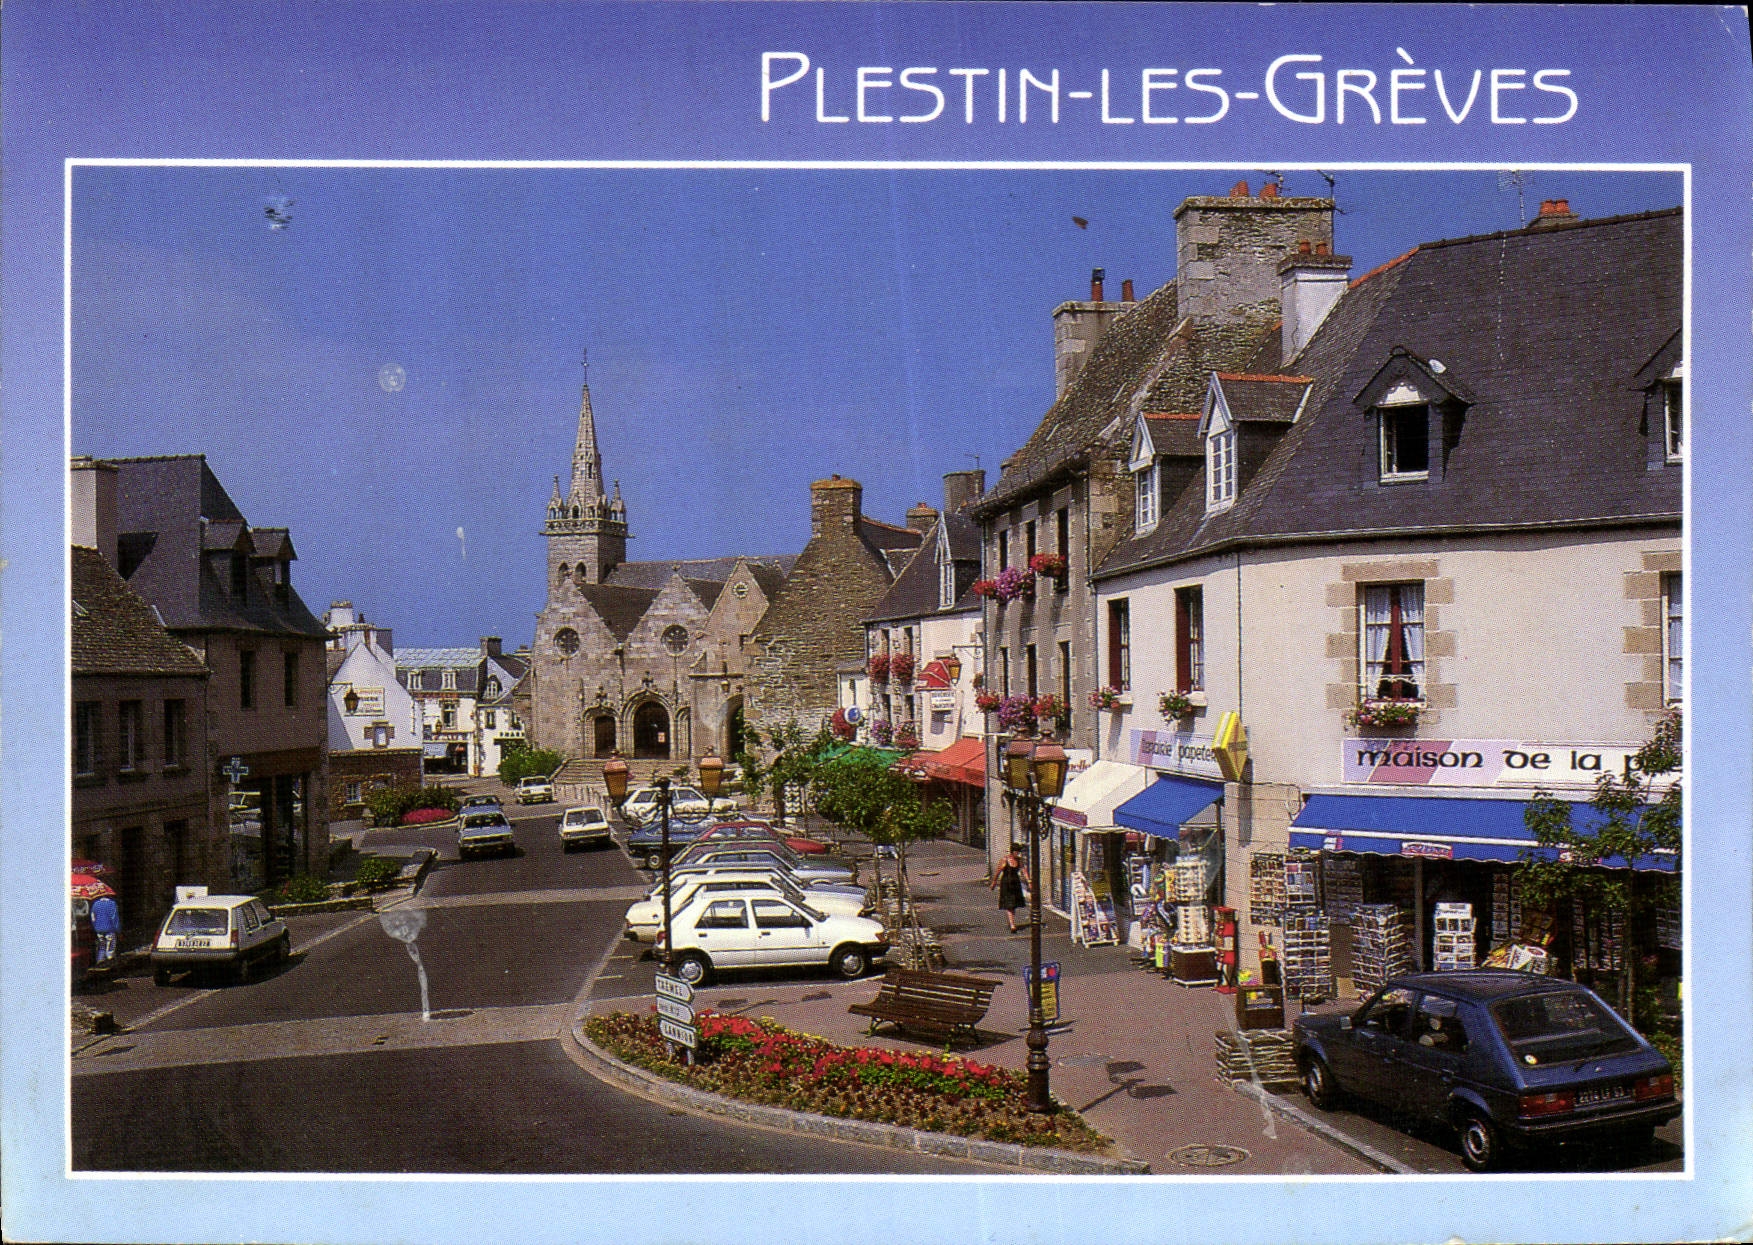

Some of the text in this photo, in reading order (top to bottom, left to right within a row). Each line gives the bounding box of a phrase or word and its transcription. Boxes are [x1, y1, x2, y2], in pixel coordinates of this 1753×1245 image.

[1356, 748, 1484, 768] maison
[1503, 749, 1552, 770] de
[1570, 750, 1602, 770] la
